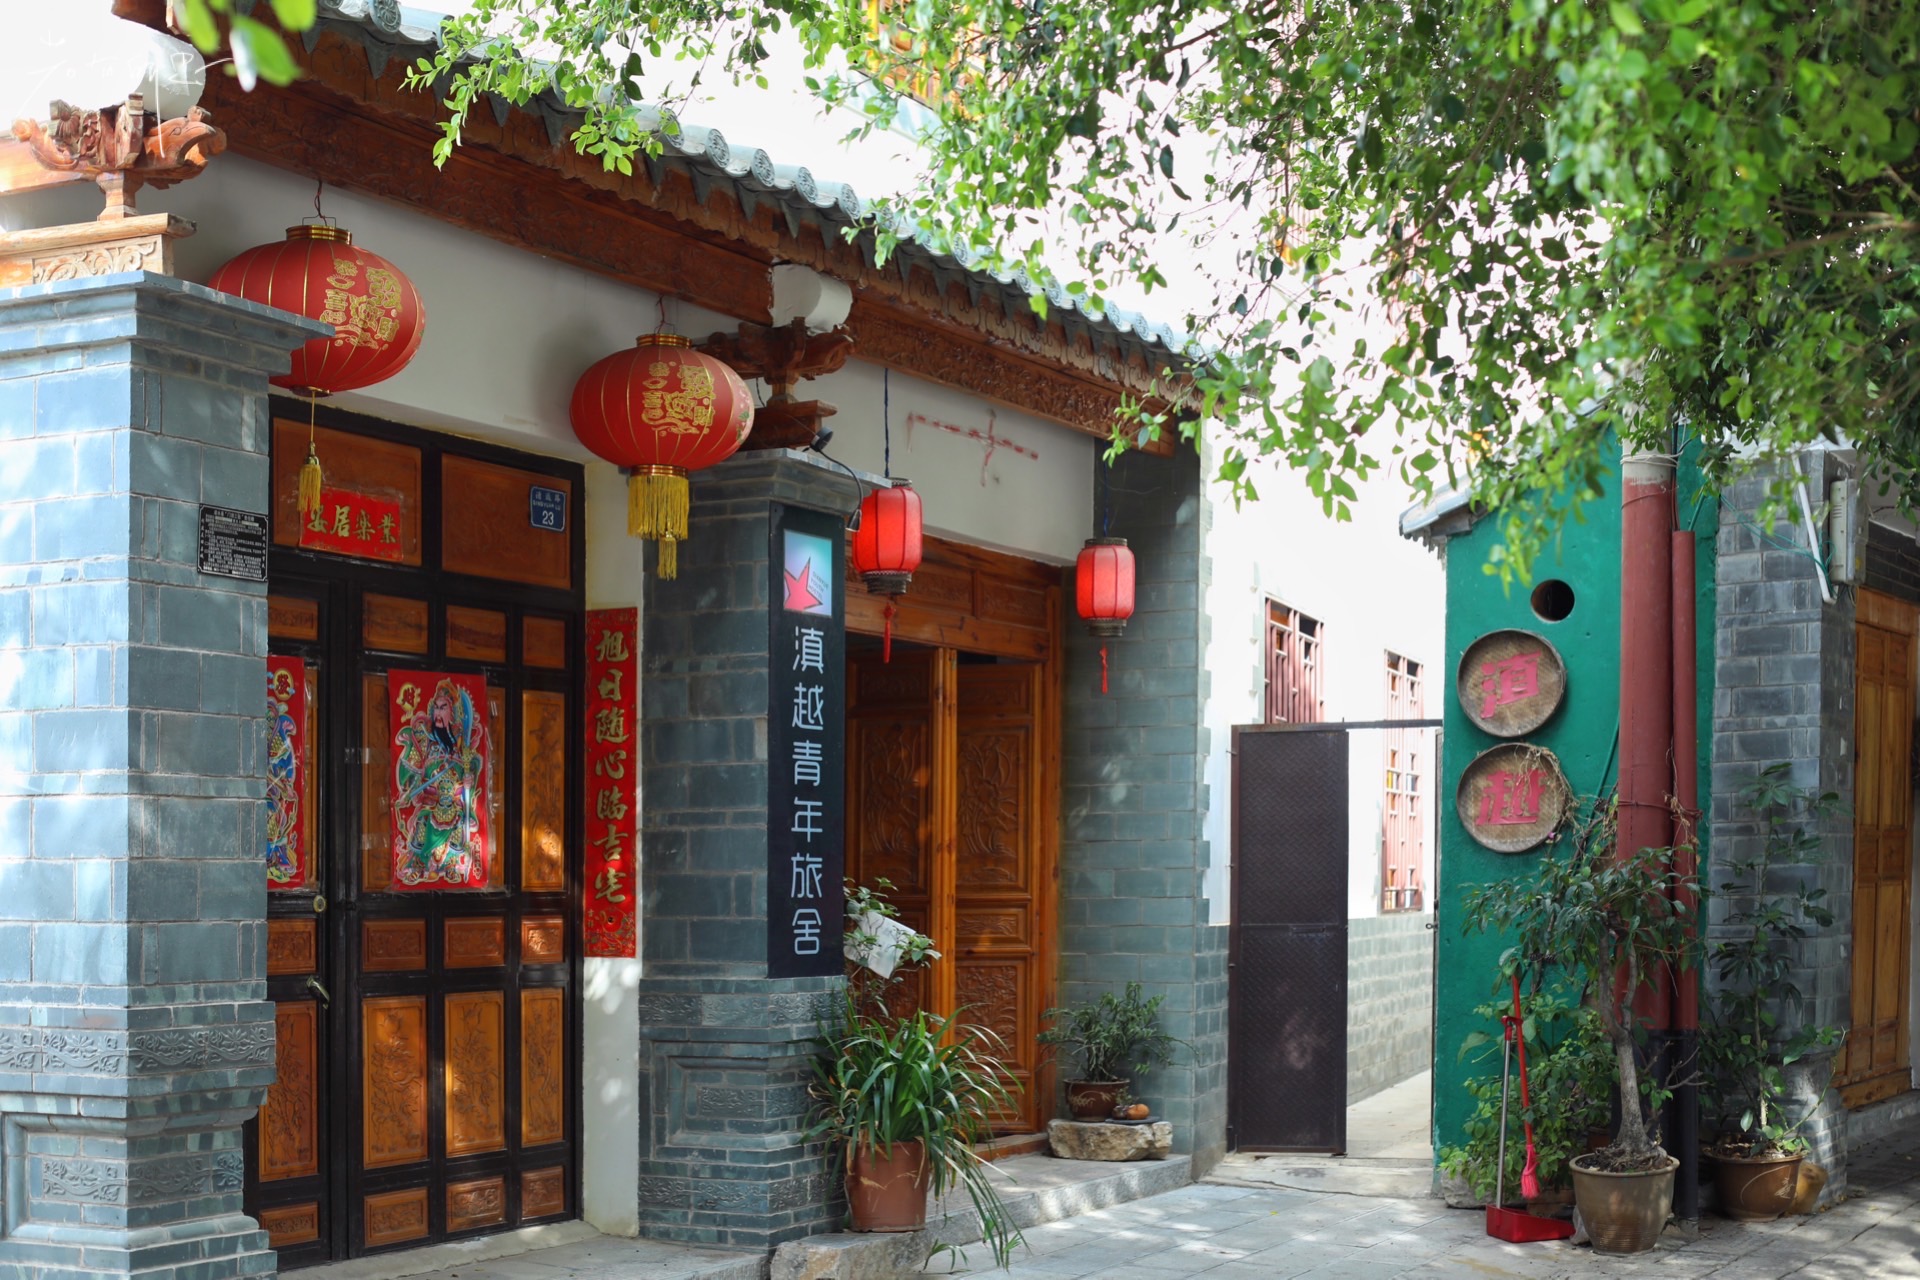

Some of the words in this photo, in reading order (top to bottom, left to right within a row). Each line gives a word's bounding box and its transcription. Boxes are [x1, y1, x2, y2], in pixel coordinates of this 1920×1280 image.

[542, 510, 554, 525] 23
[791, 626, 824, 955] 滇越青年旅舍
